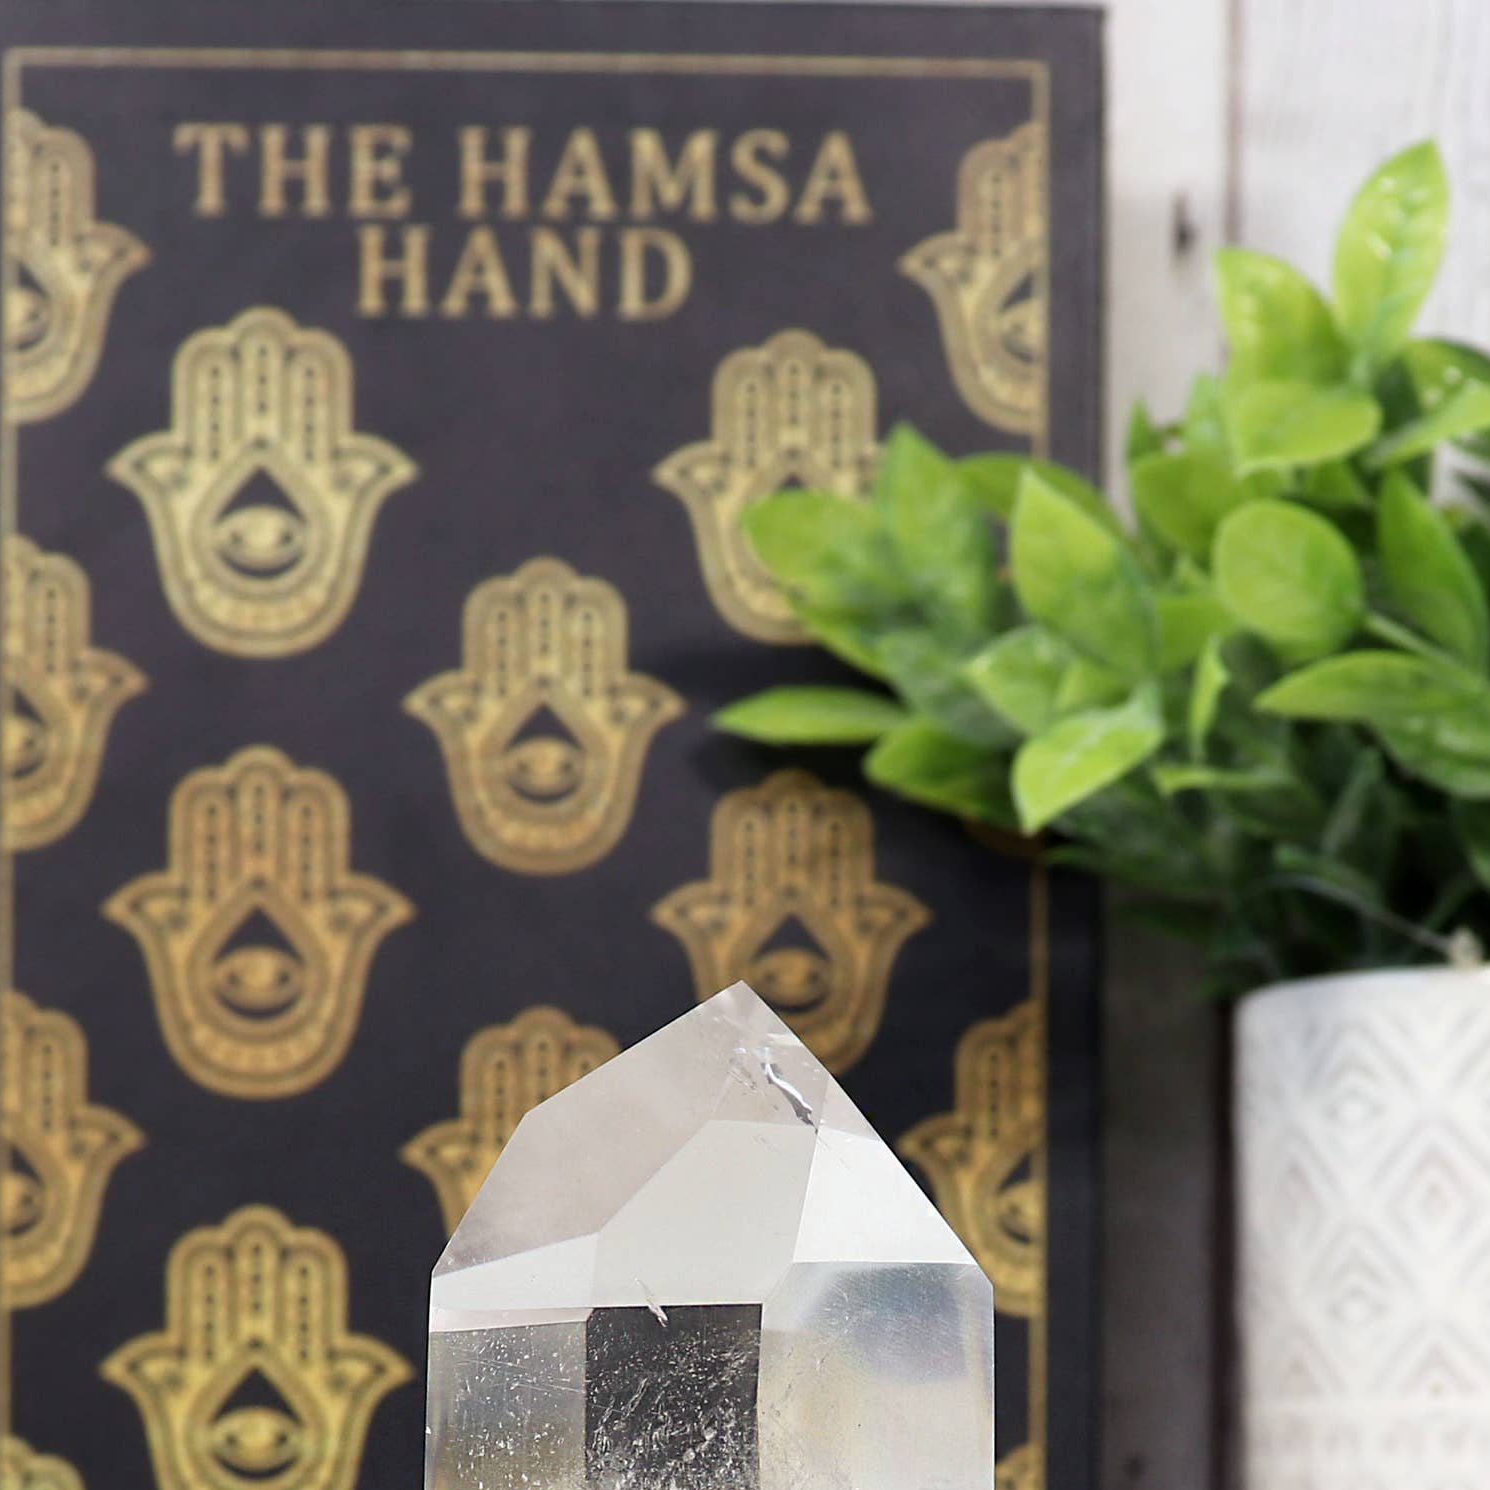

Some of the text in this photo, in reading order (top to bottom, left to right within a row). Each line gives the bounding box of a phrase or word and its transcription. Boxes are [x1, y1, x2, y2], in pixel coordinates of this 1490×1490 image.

[173, 122, 874, 225] THE HAMSA
[359, 223, 694, 320] HAND
